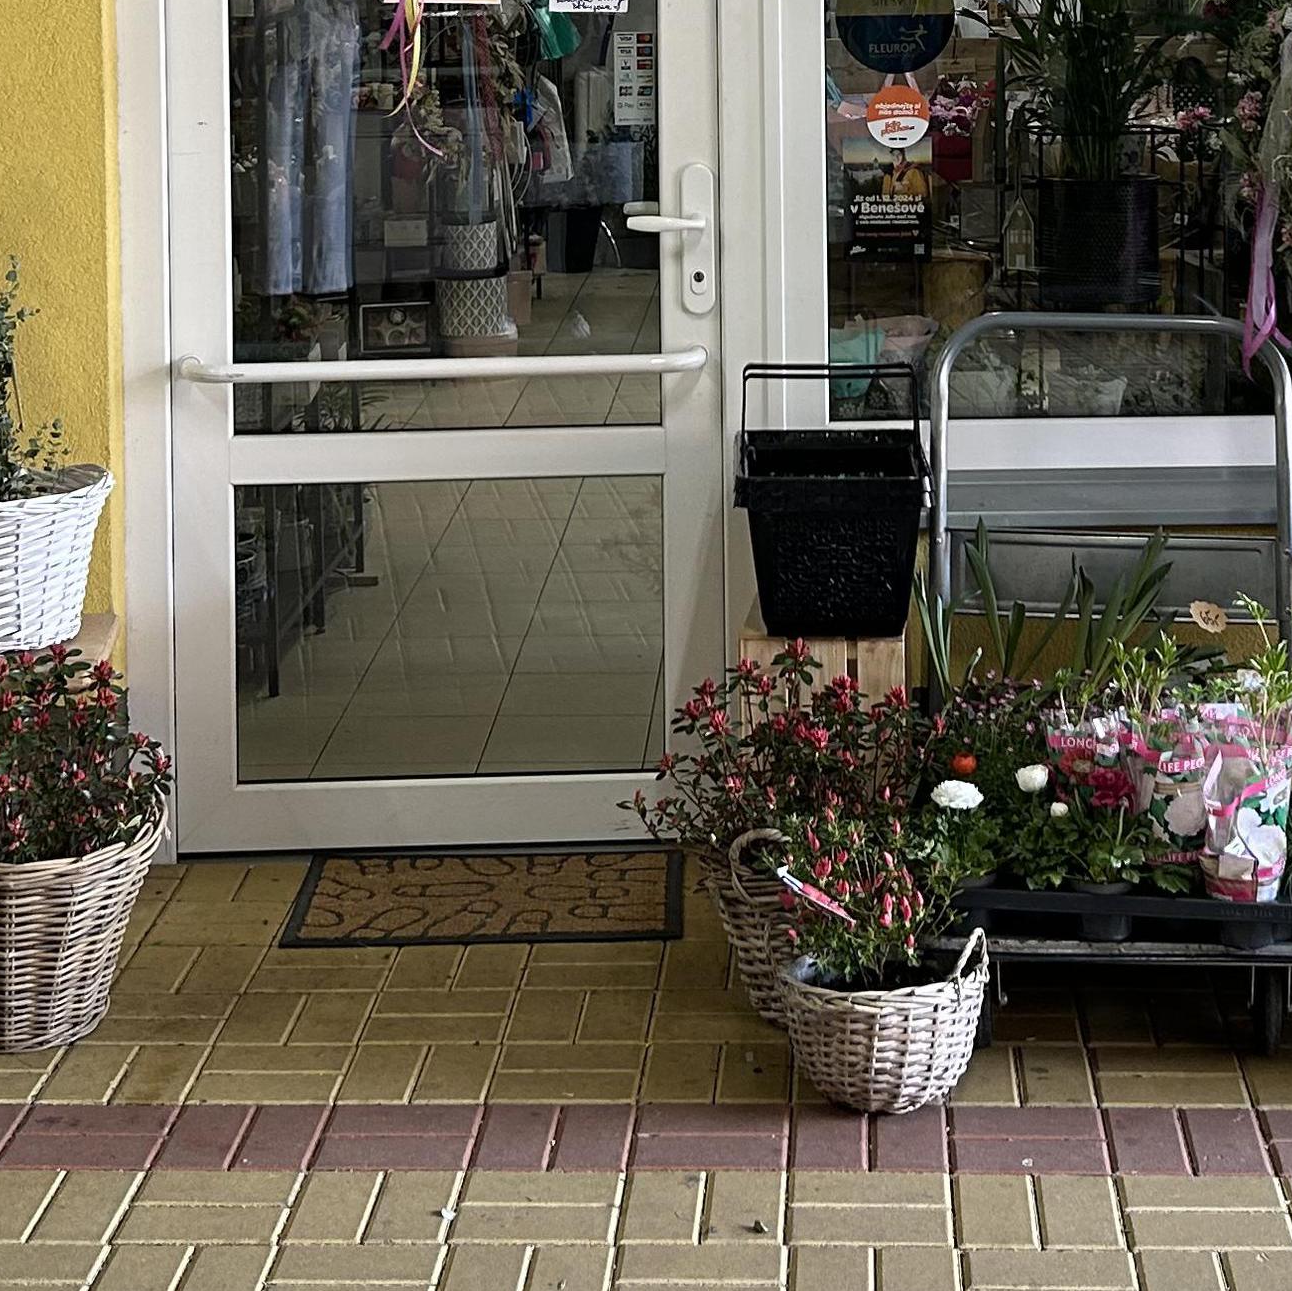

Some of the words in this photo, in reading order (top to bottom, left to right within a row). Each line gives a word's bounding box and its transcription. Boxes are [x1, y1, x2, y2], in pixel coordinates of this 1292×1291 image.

[868, 43, 917, 54] FLEUROP
[865, 194, 876, 203] od
[893, 194, 914, 203] 2024
[849, 204, 859, 214] v
[860, 201, 926, 214] Benešově
